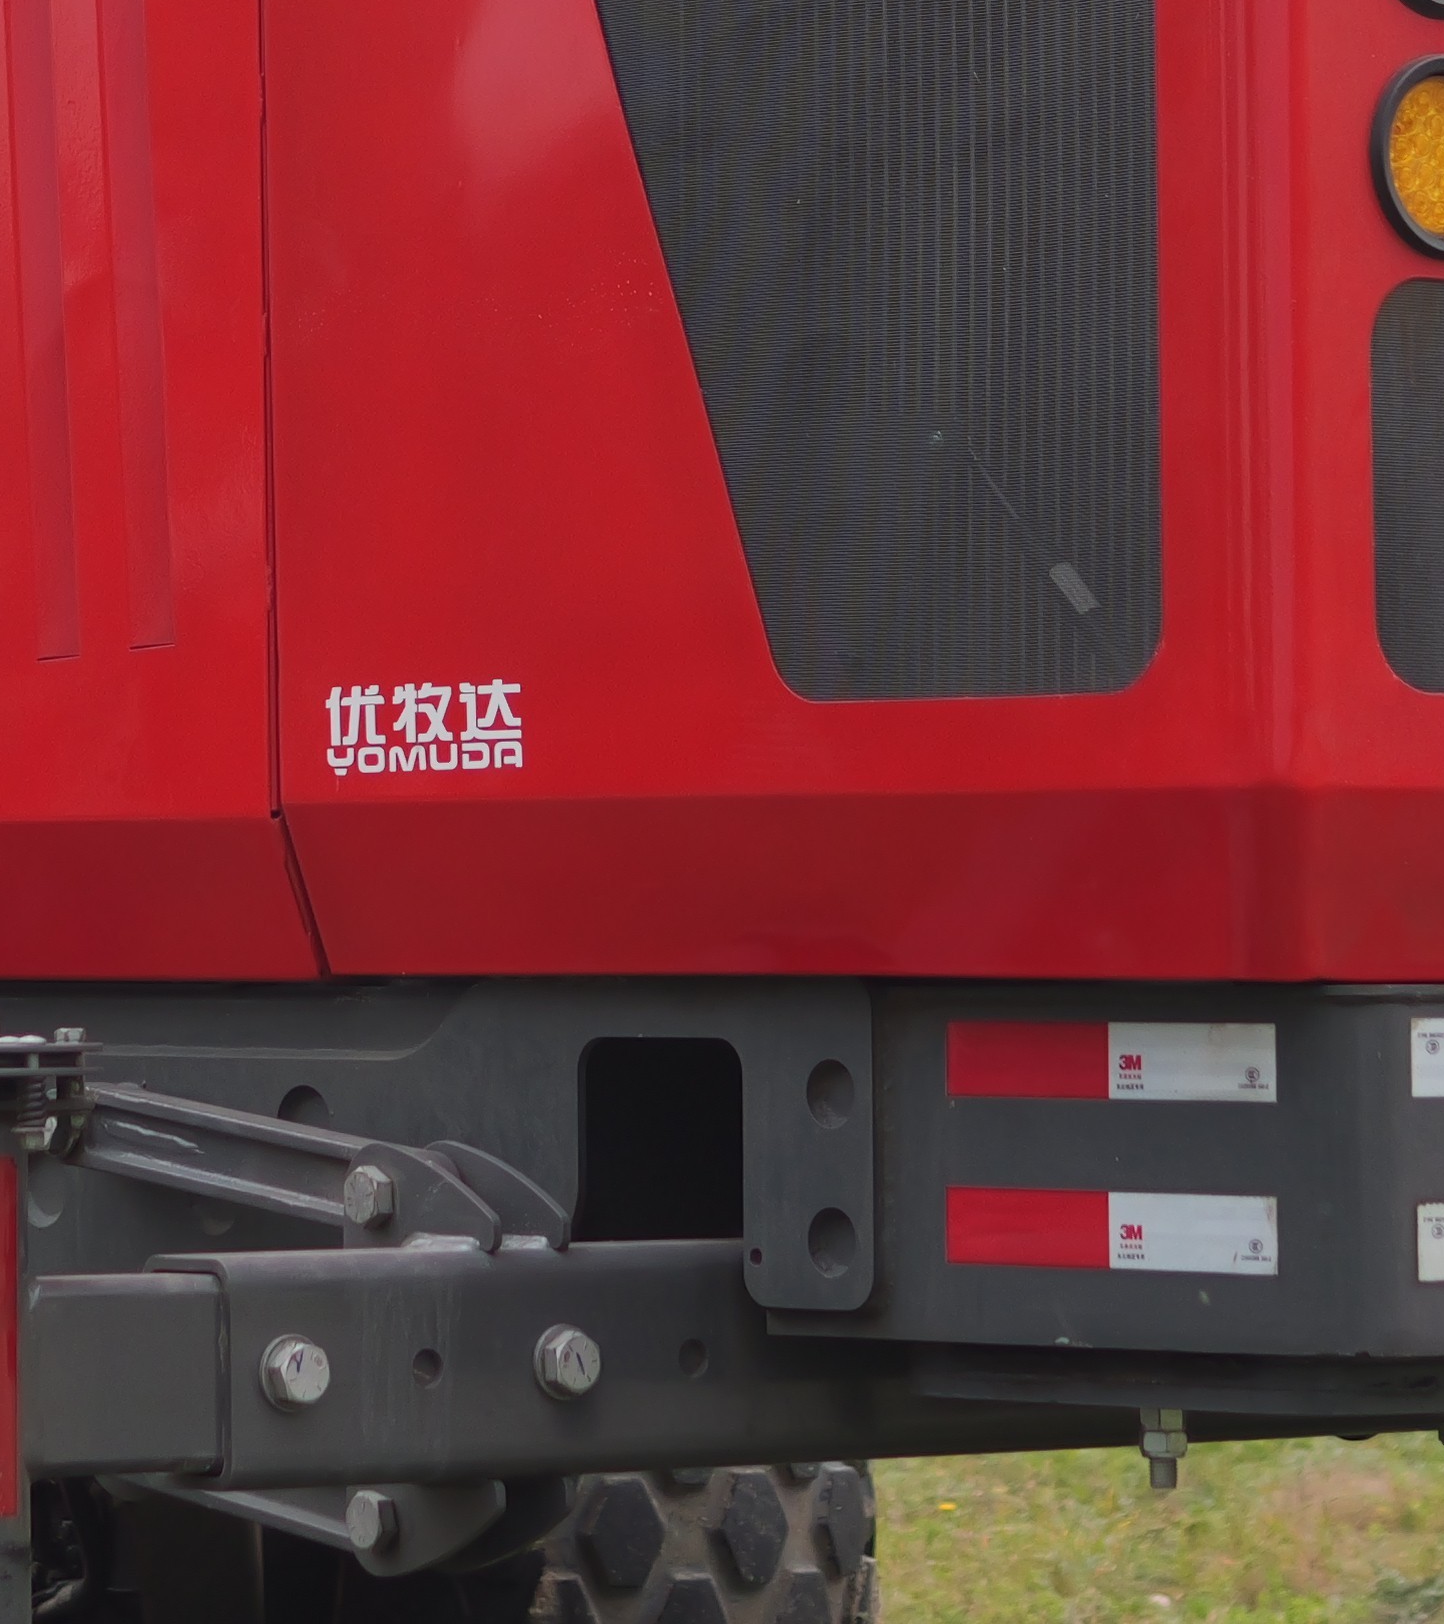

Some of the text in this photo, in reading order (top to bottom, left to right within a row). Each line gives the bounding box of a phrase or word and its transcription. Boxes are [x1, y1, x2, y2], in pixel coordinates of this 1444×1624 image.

[325, 678, 523, 747] 优牧达
[326, 740, 524, 777] YOMUDA
[1118, 1054, 1142, 1071] 3M
[1120, 1223, 1143, 1241] 3M
